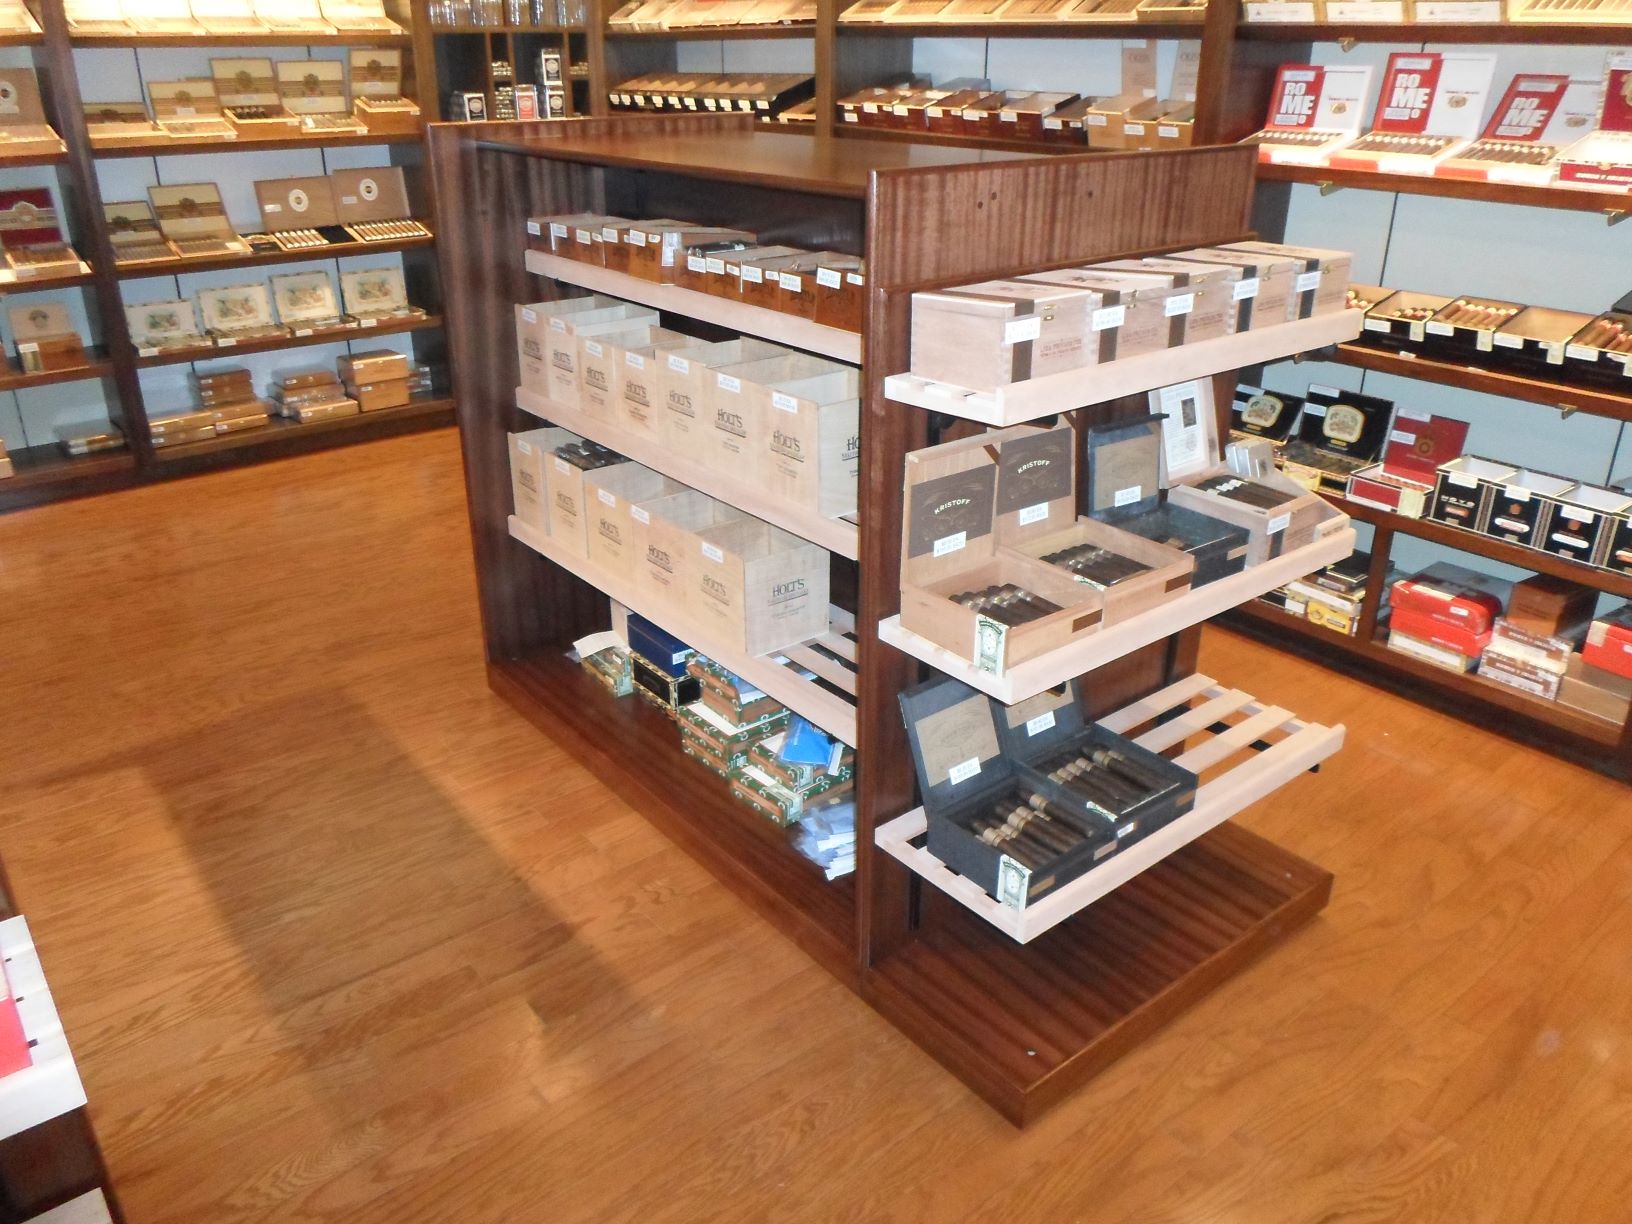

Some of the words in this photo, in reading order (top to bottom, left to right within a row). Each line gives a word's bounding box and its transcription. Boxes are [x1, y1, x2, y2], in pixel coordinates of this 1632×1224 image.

[1284, 82, 1307, 96] RO
[1395, 73, 1421, 88] RO
[1280, 95, 1315, 115] ME
[1390, 87, 1431, 109] ME
[1501, 108, 1549, 127] ME
[586, 365, 605, 384] HOLT'S
[626, 379, 647, 400] HOLT'S
[669, 389, 692, 409] HOLT'S
[717, 408, 743, 429] HOLT'S
[773, 429, 801, 453] HOLT'S
[1017, 459, 1051, 475] KRISTOFF
[934, 497, 972, 515] KRISTOFF
[600, 517, 620, 537] HOLT'S
[648, 544, 671, 564] HOLT'S
[703, 574, 727, 596] HOLT'S
[772, 578, 805, 597] HOLT'S
